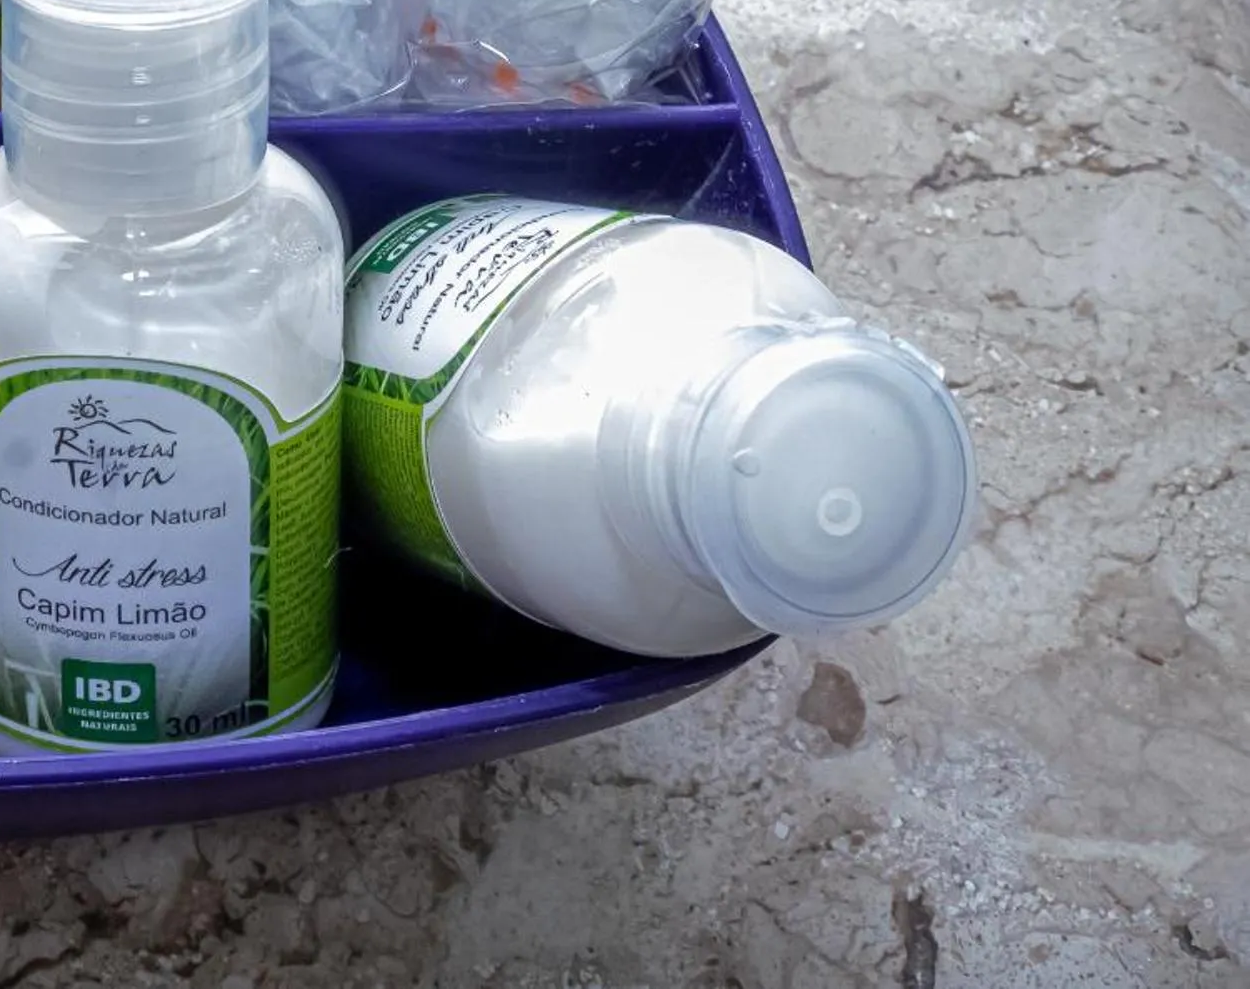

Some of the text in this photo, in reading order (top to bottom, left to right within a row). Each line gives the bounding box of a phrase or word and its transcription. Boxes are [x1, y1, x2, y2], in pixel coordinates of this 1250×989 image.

[379, 251, 438, 322] Limão
[411, 282, 454, 352] Natural
[52, 426, 178, 470] Riquezas
[49, 458, 177, 489] Terra
[151, 500, 227, 526] Natural
[11, 553, 207, 589] Anti stress
[17, 587, 207, 626] Capim Limão
[75, 676, 141, 704] IBD
[67, 705, 151, 721] INGREDIENTES
[80, 719, 138, 733] NATURAIS
[165, 699, 247, 739] 30 ml
